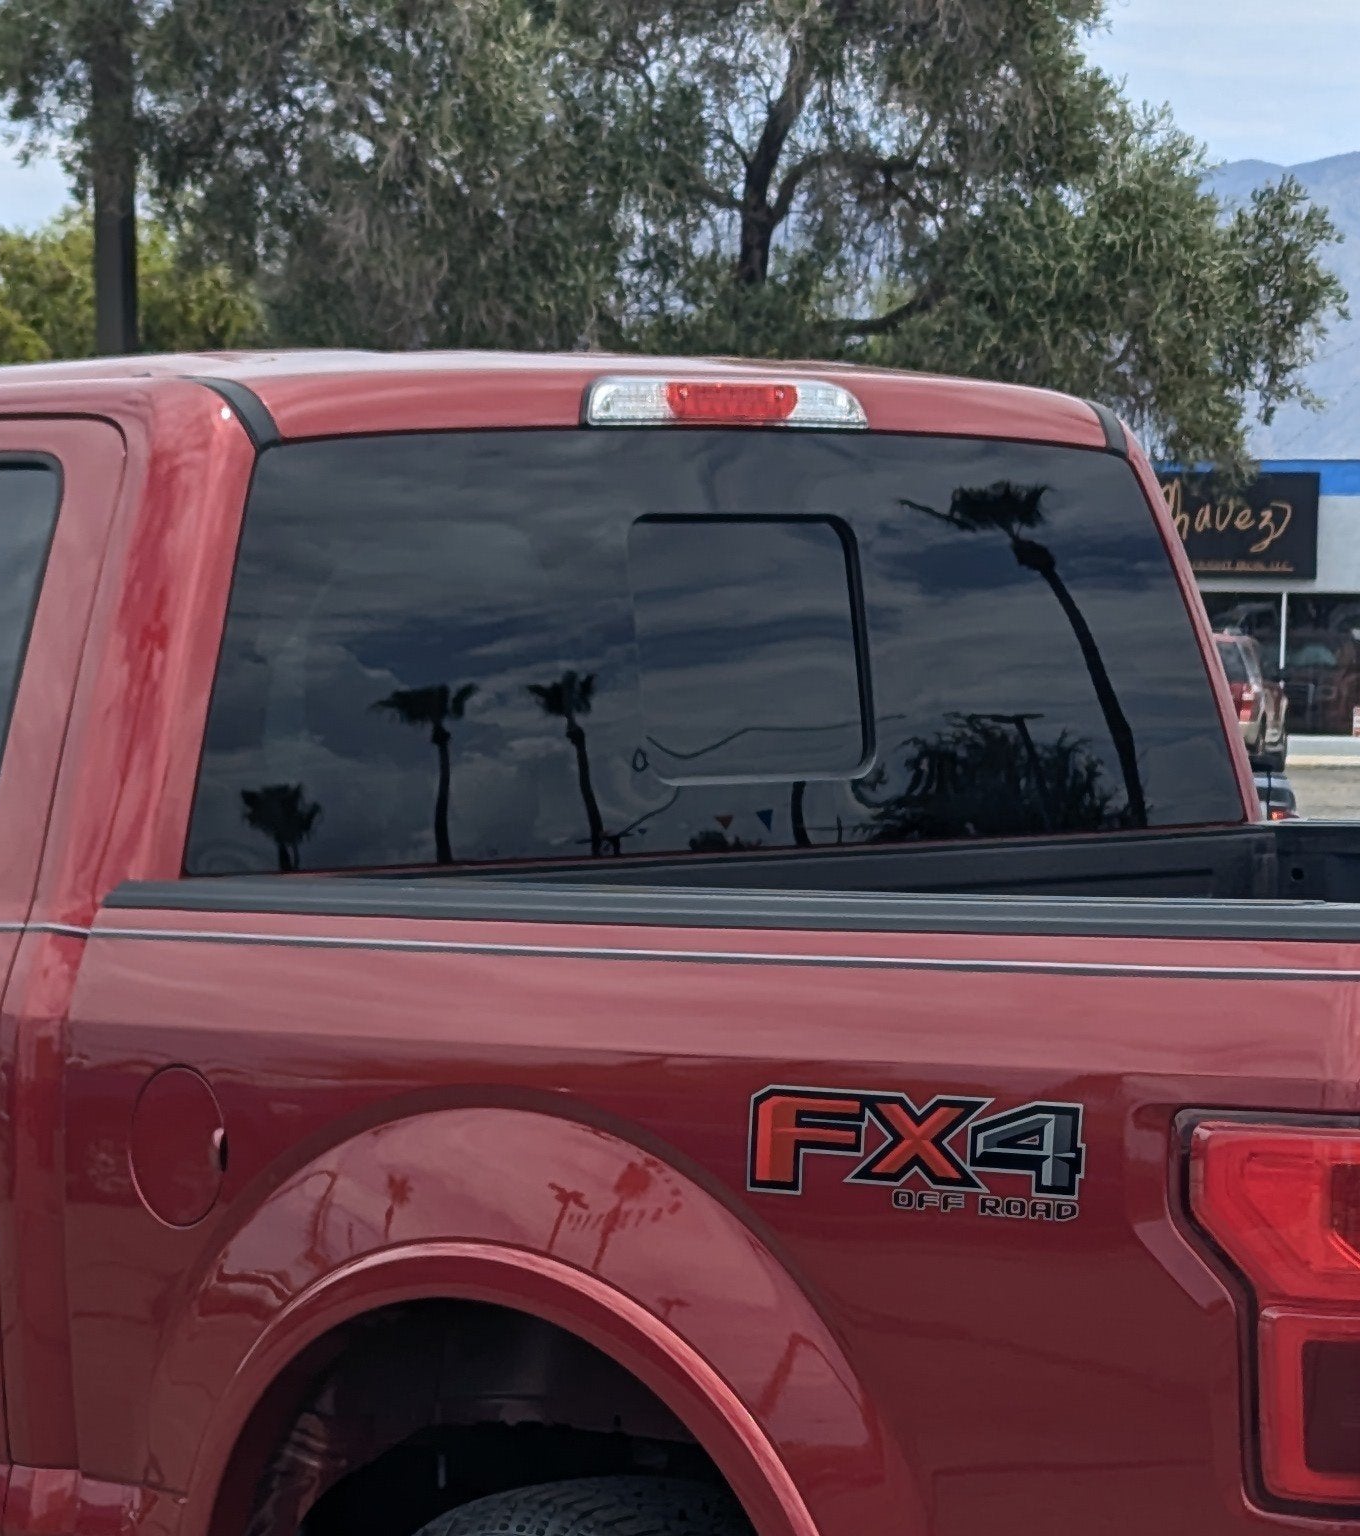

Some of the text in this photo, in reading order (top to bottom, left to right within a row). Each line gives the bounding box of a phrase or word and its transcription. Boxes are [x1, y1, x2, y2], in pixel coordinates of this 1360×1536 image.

[746, 1084, 1086, 1201] FX4
[892, 1188, 1080, 1222] OFF ROAD
